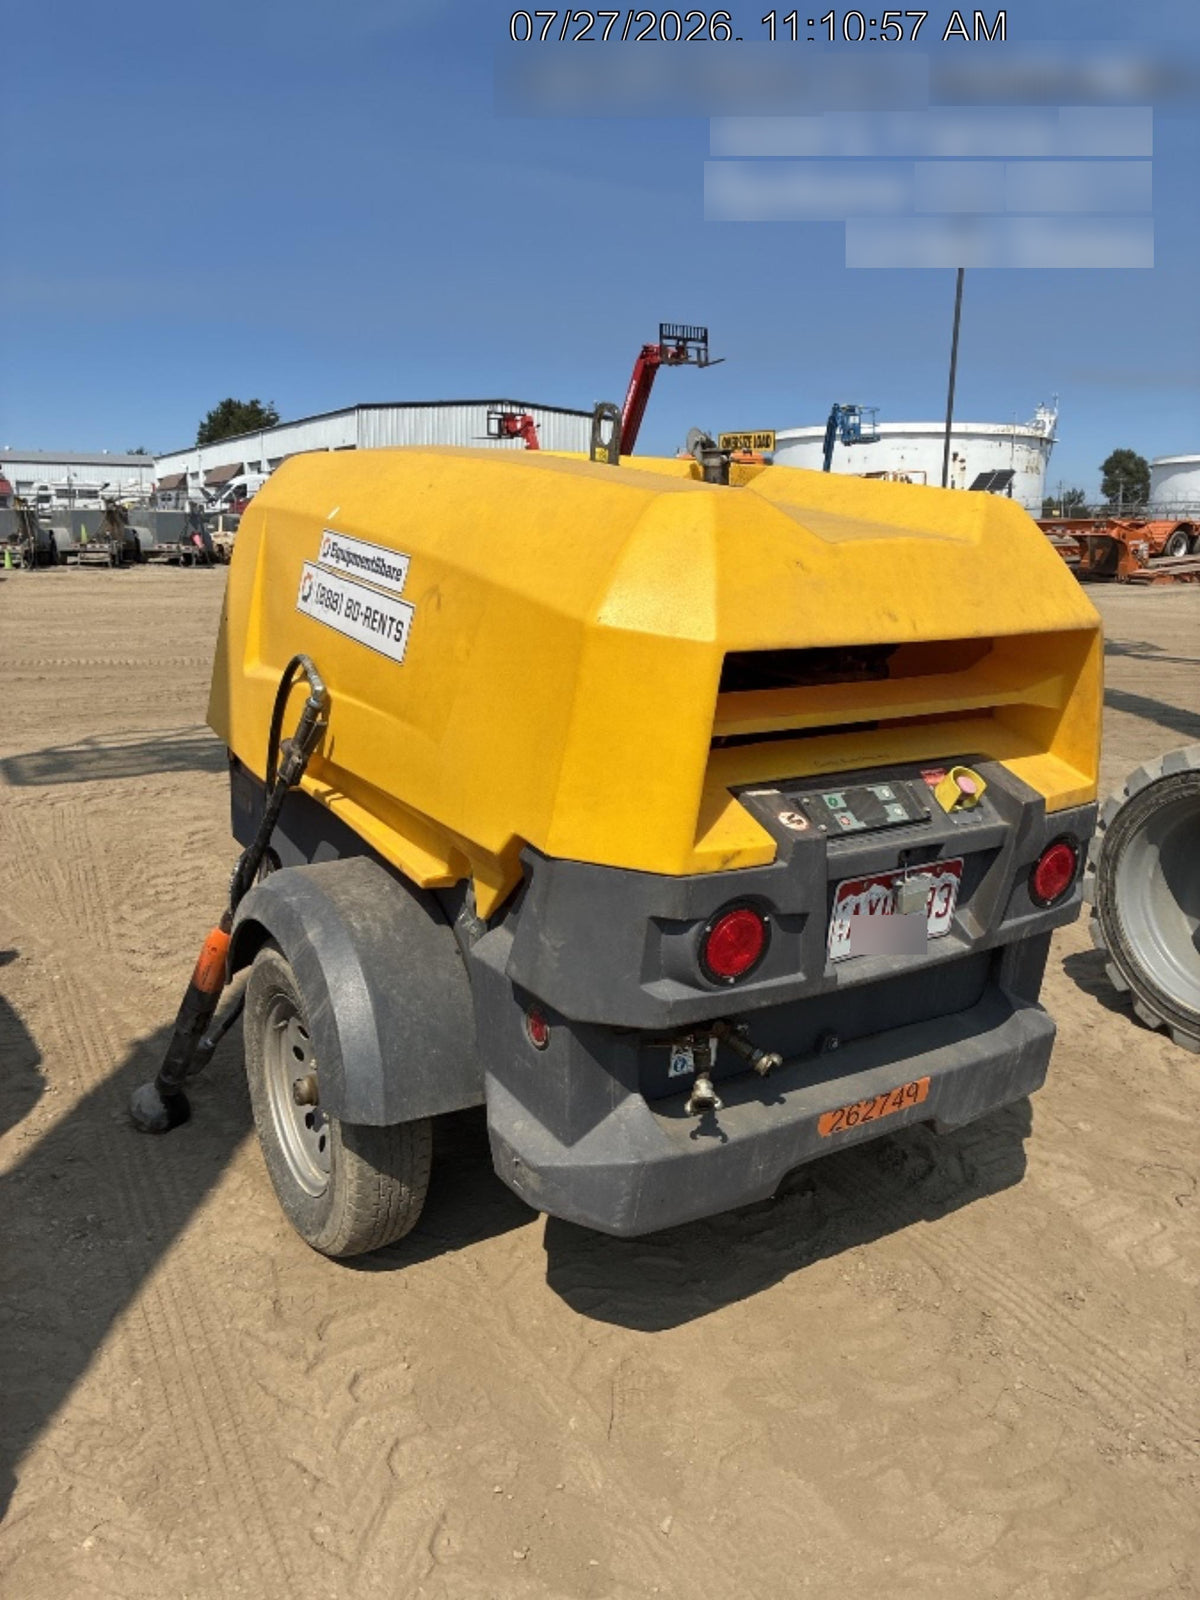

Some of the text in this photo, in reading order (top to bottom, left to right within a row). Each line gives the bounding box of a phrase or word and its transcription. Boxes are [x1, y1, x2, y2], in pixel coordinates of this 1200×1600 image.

[330, 541, 403, 582] EquipmentShare
[344, 598, 404, 643] 80-RENTS
[828, 1082, 919, 1132] 262749
